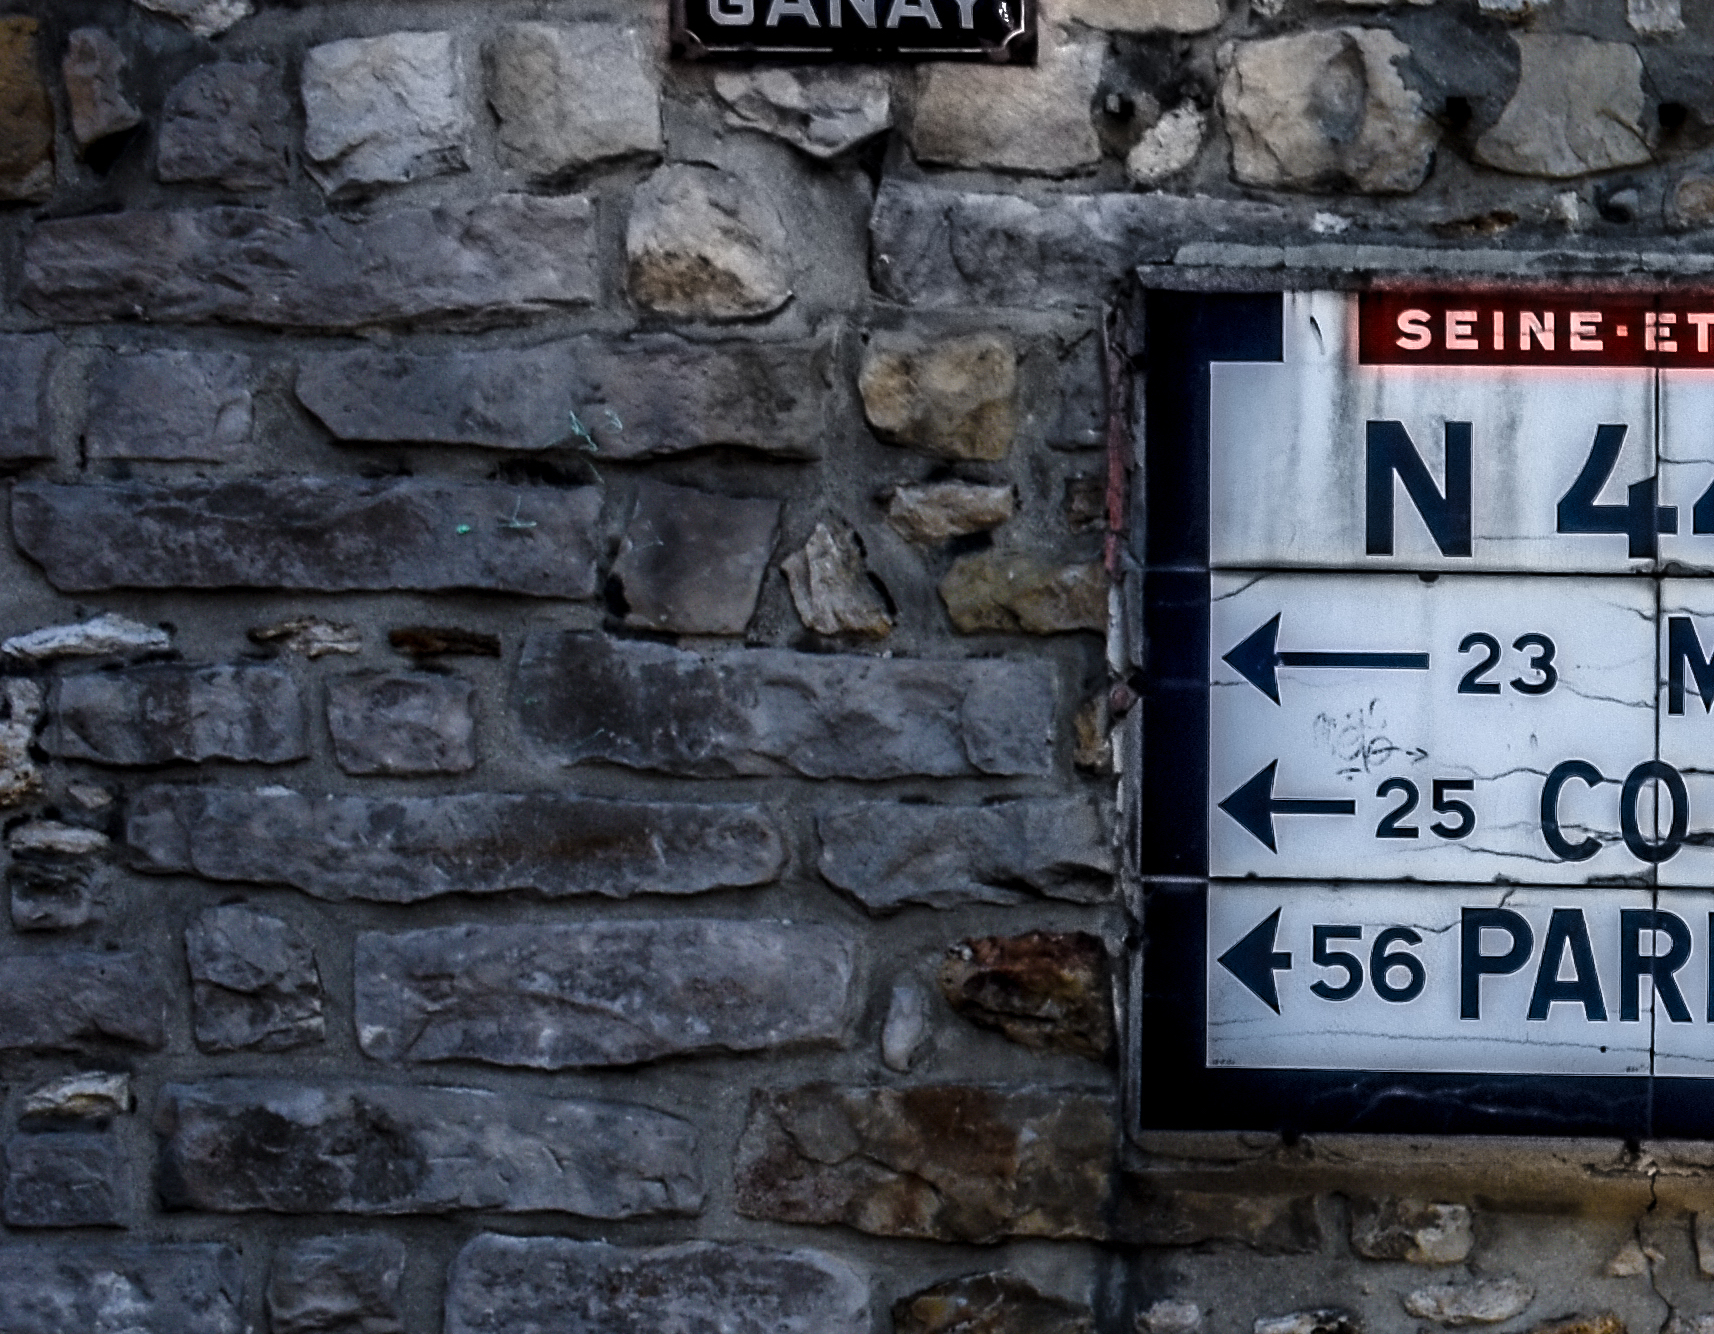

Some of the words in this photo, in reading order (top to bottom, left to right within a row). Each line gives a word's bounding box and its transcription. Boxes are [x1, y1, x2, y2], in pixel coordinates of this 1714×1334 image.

[1365, 421, 1473, 557] N
[1457, 632, 1558, 695] 23
[1375, 777, 1476, 839] 25
[1309, 925, 1426, 1002] 56
